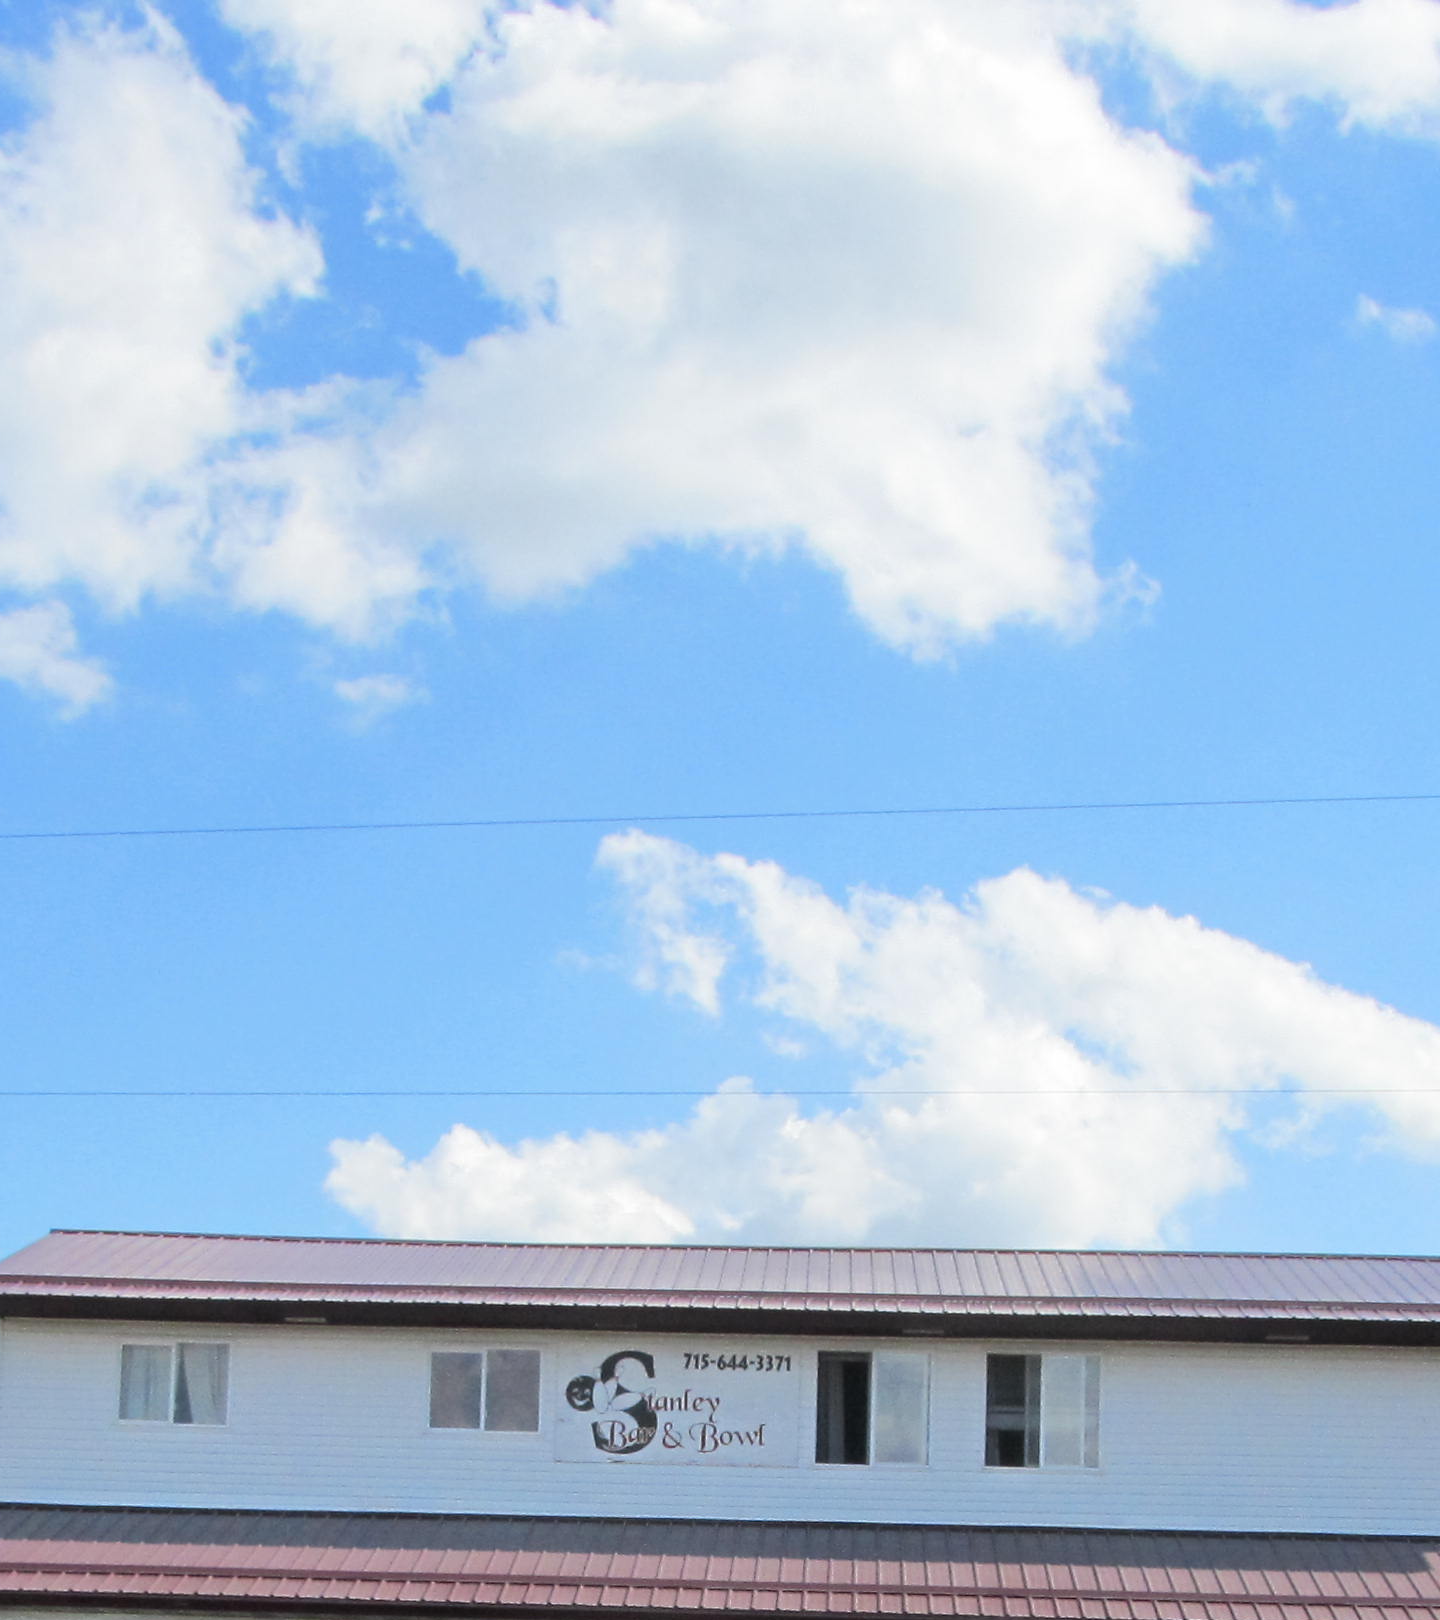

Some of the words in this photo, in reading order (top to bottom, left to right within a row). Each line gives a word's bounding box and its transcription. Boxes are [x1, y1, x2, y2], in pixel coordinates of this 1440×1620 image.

[683, 1353, 792, 1371] 715-644-3371
[596, 1420, 656, 1450] Bar
[662, 1422, 685, 1449] &
[688, 1422, 766, 1453] Bowl
